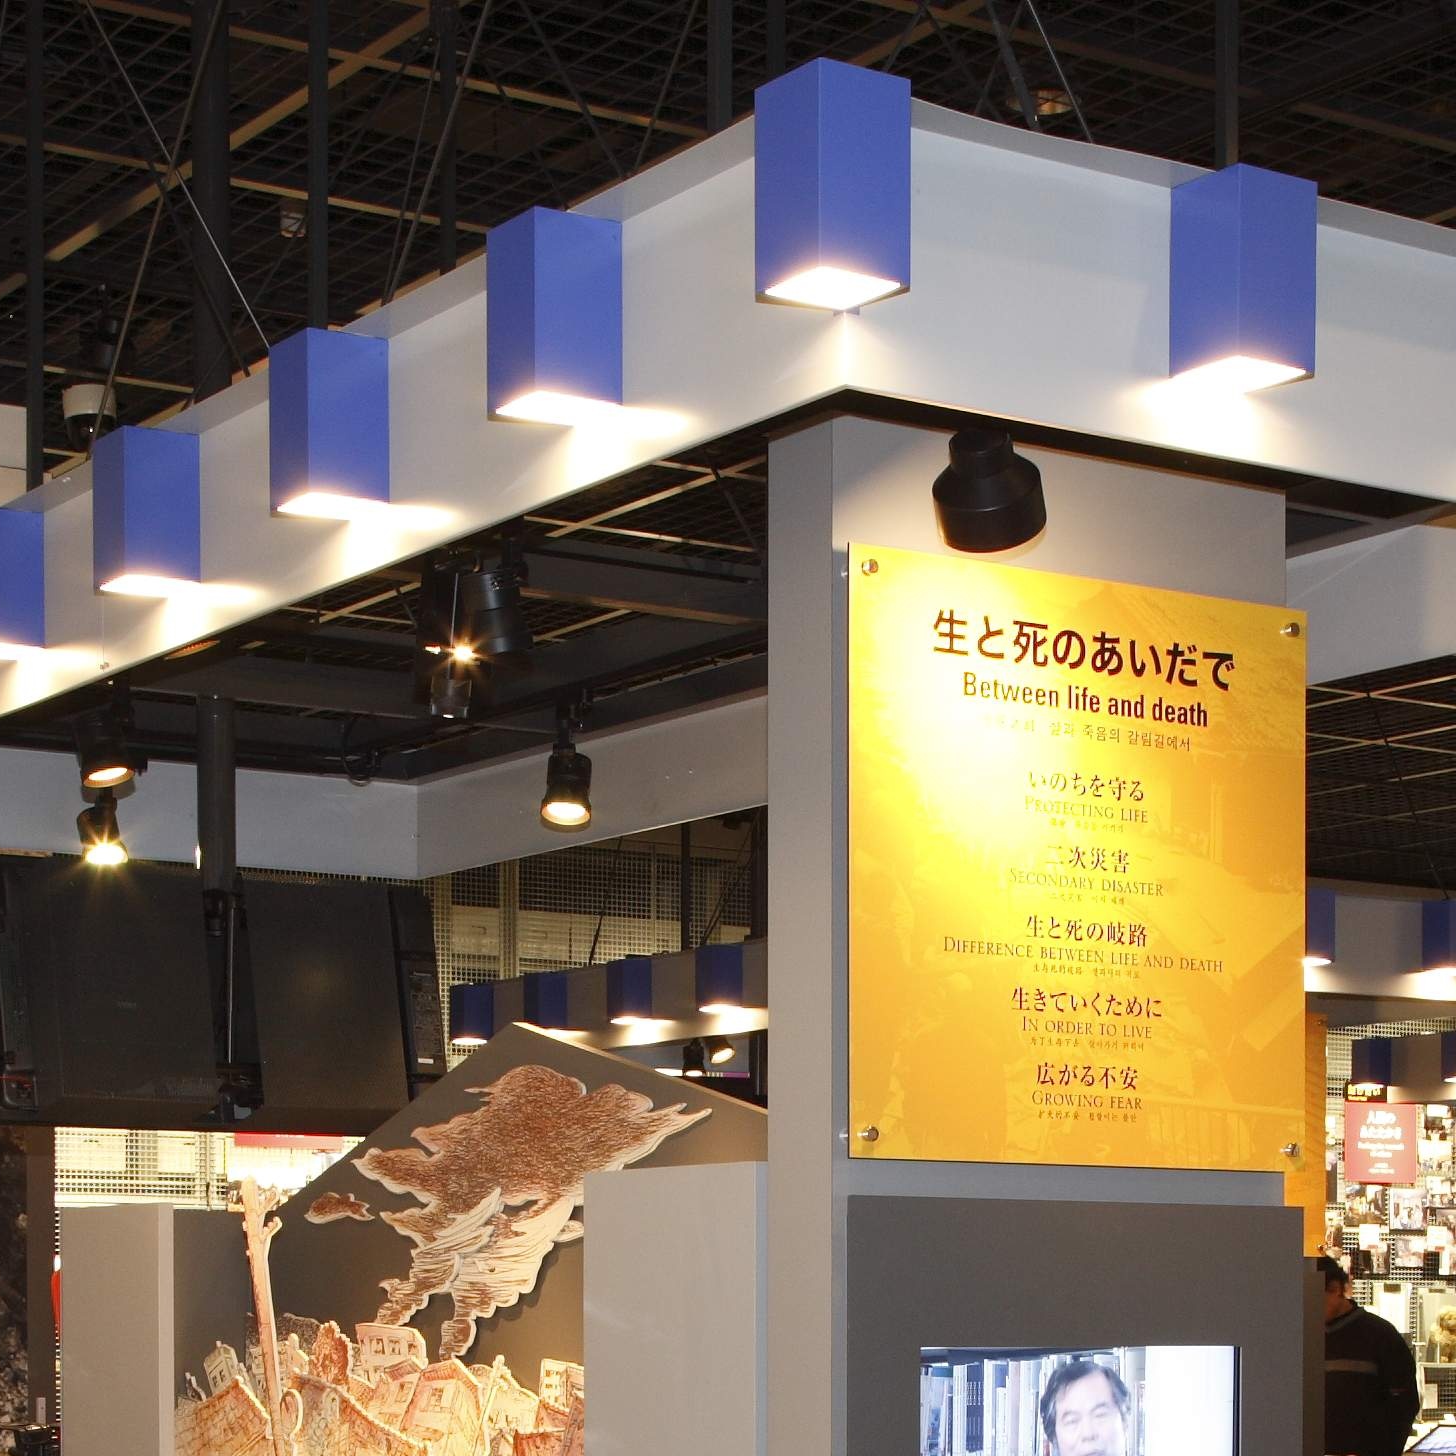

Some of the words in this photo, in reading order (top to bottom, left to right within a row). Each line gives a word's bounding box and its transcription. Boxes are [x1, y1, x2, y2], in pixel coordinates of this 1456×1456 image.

[932, 609, 1236, 692] 生と死のあいだで
[962, 671, 1060, 708] Between
[1067, 685, 1101, 714] life
[1108, 694, 1145, 719] and
[1151, 699, 1209, 727] death
[1028, 770, 1145, 802] いのちを守る
[1119, 807, 1149, 824] LIFE
[1044, 846, 1130, 874] 二次災害
[1026, 914, 1148, 948] 生と死の岐路
[1011, 986, 1163, 1019] 生きていくために
[1036, 1062, 1139, 1091] 広がる不安
